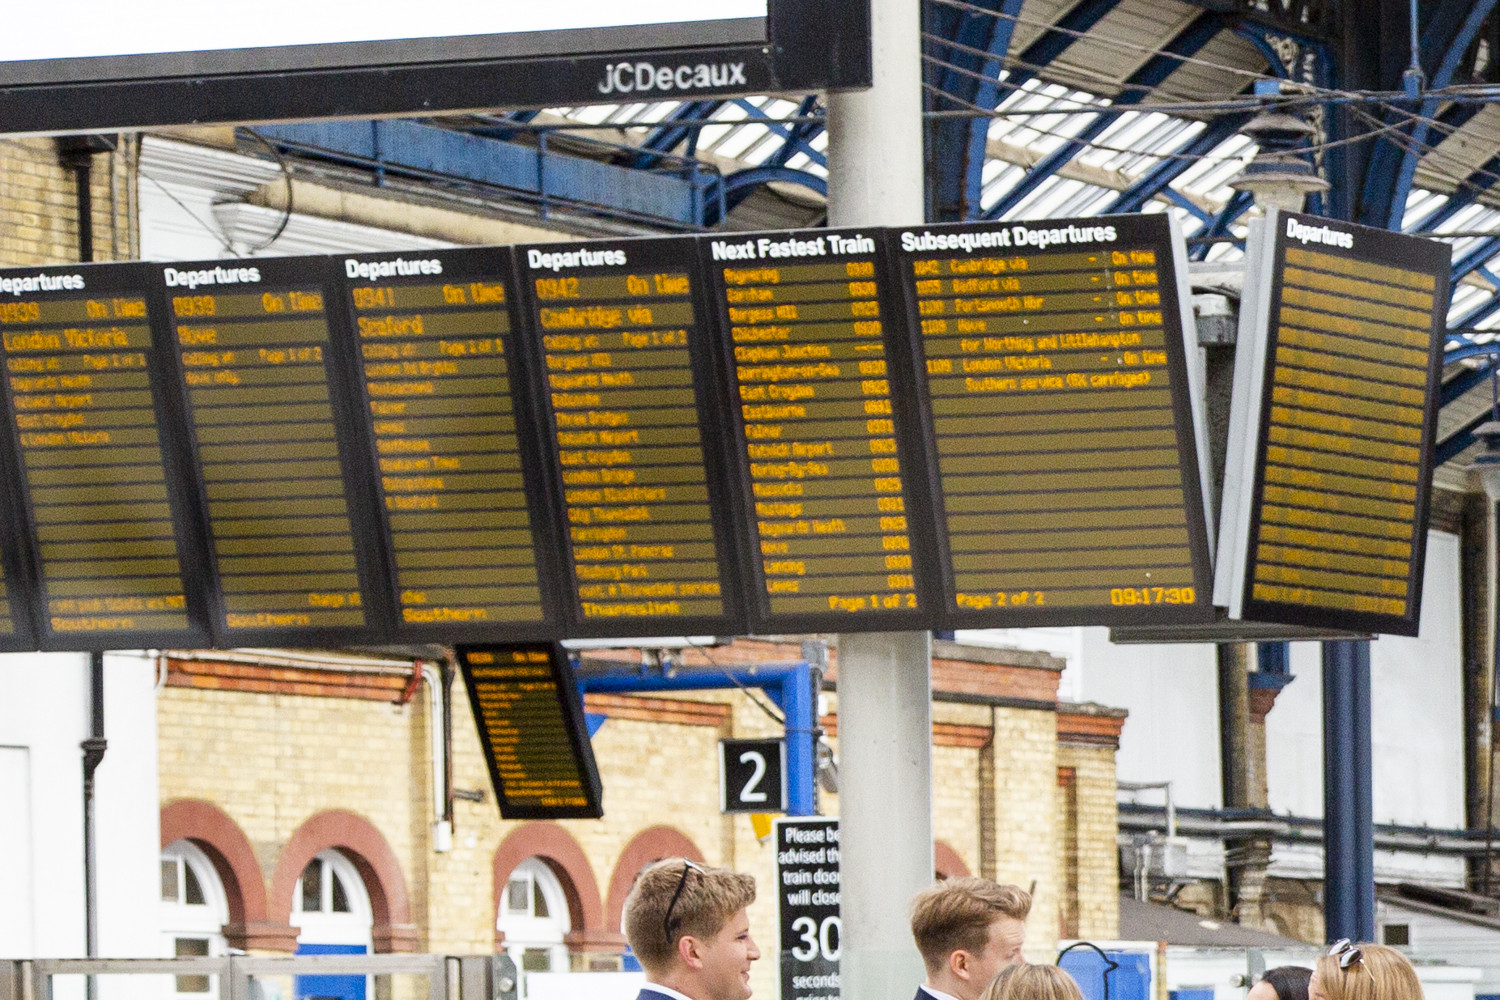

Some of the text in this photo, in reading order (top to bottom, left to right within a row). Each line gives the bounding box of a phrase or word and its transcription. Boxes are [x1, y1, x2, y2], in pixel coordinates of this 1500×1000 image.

[901, 225, 1117, 253] Subsequent Departures
[1287, 217, 1354, 249] Departures
[711, 233, 876, 260] Next Fastest Train
[345, 257, 443, 281] Departures
[527, 247, 627, 272] Departures
[0, 273, 85, 296] epartures
[164, 266, 261, 289] Departures
[828, 596, 866, 613] Page
[956, 586, 1195, 609] Page 2 of 2 09:17:30
[738, 750, 768, 803] 2
[785, 826, 840, 843] Please be
[778, 847, 824, 865] advised
[783, 868, 812, 885] train
[788, 890, 810, 907] will
[791, 916, 842, 962] 30
[793, 973, 840, 990] seconds
